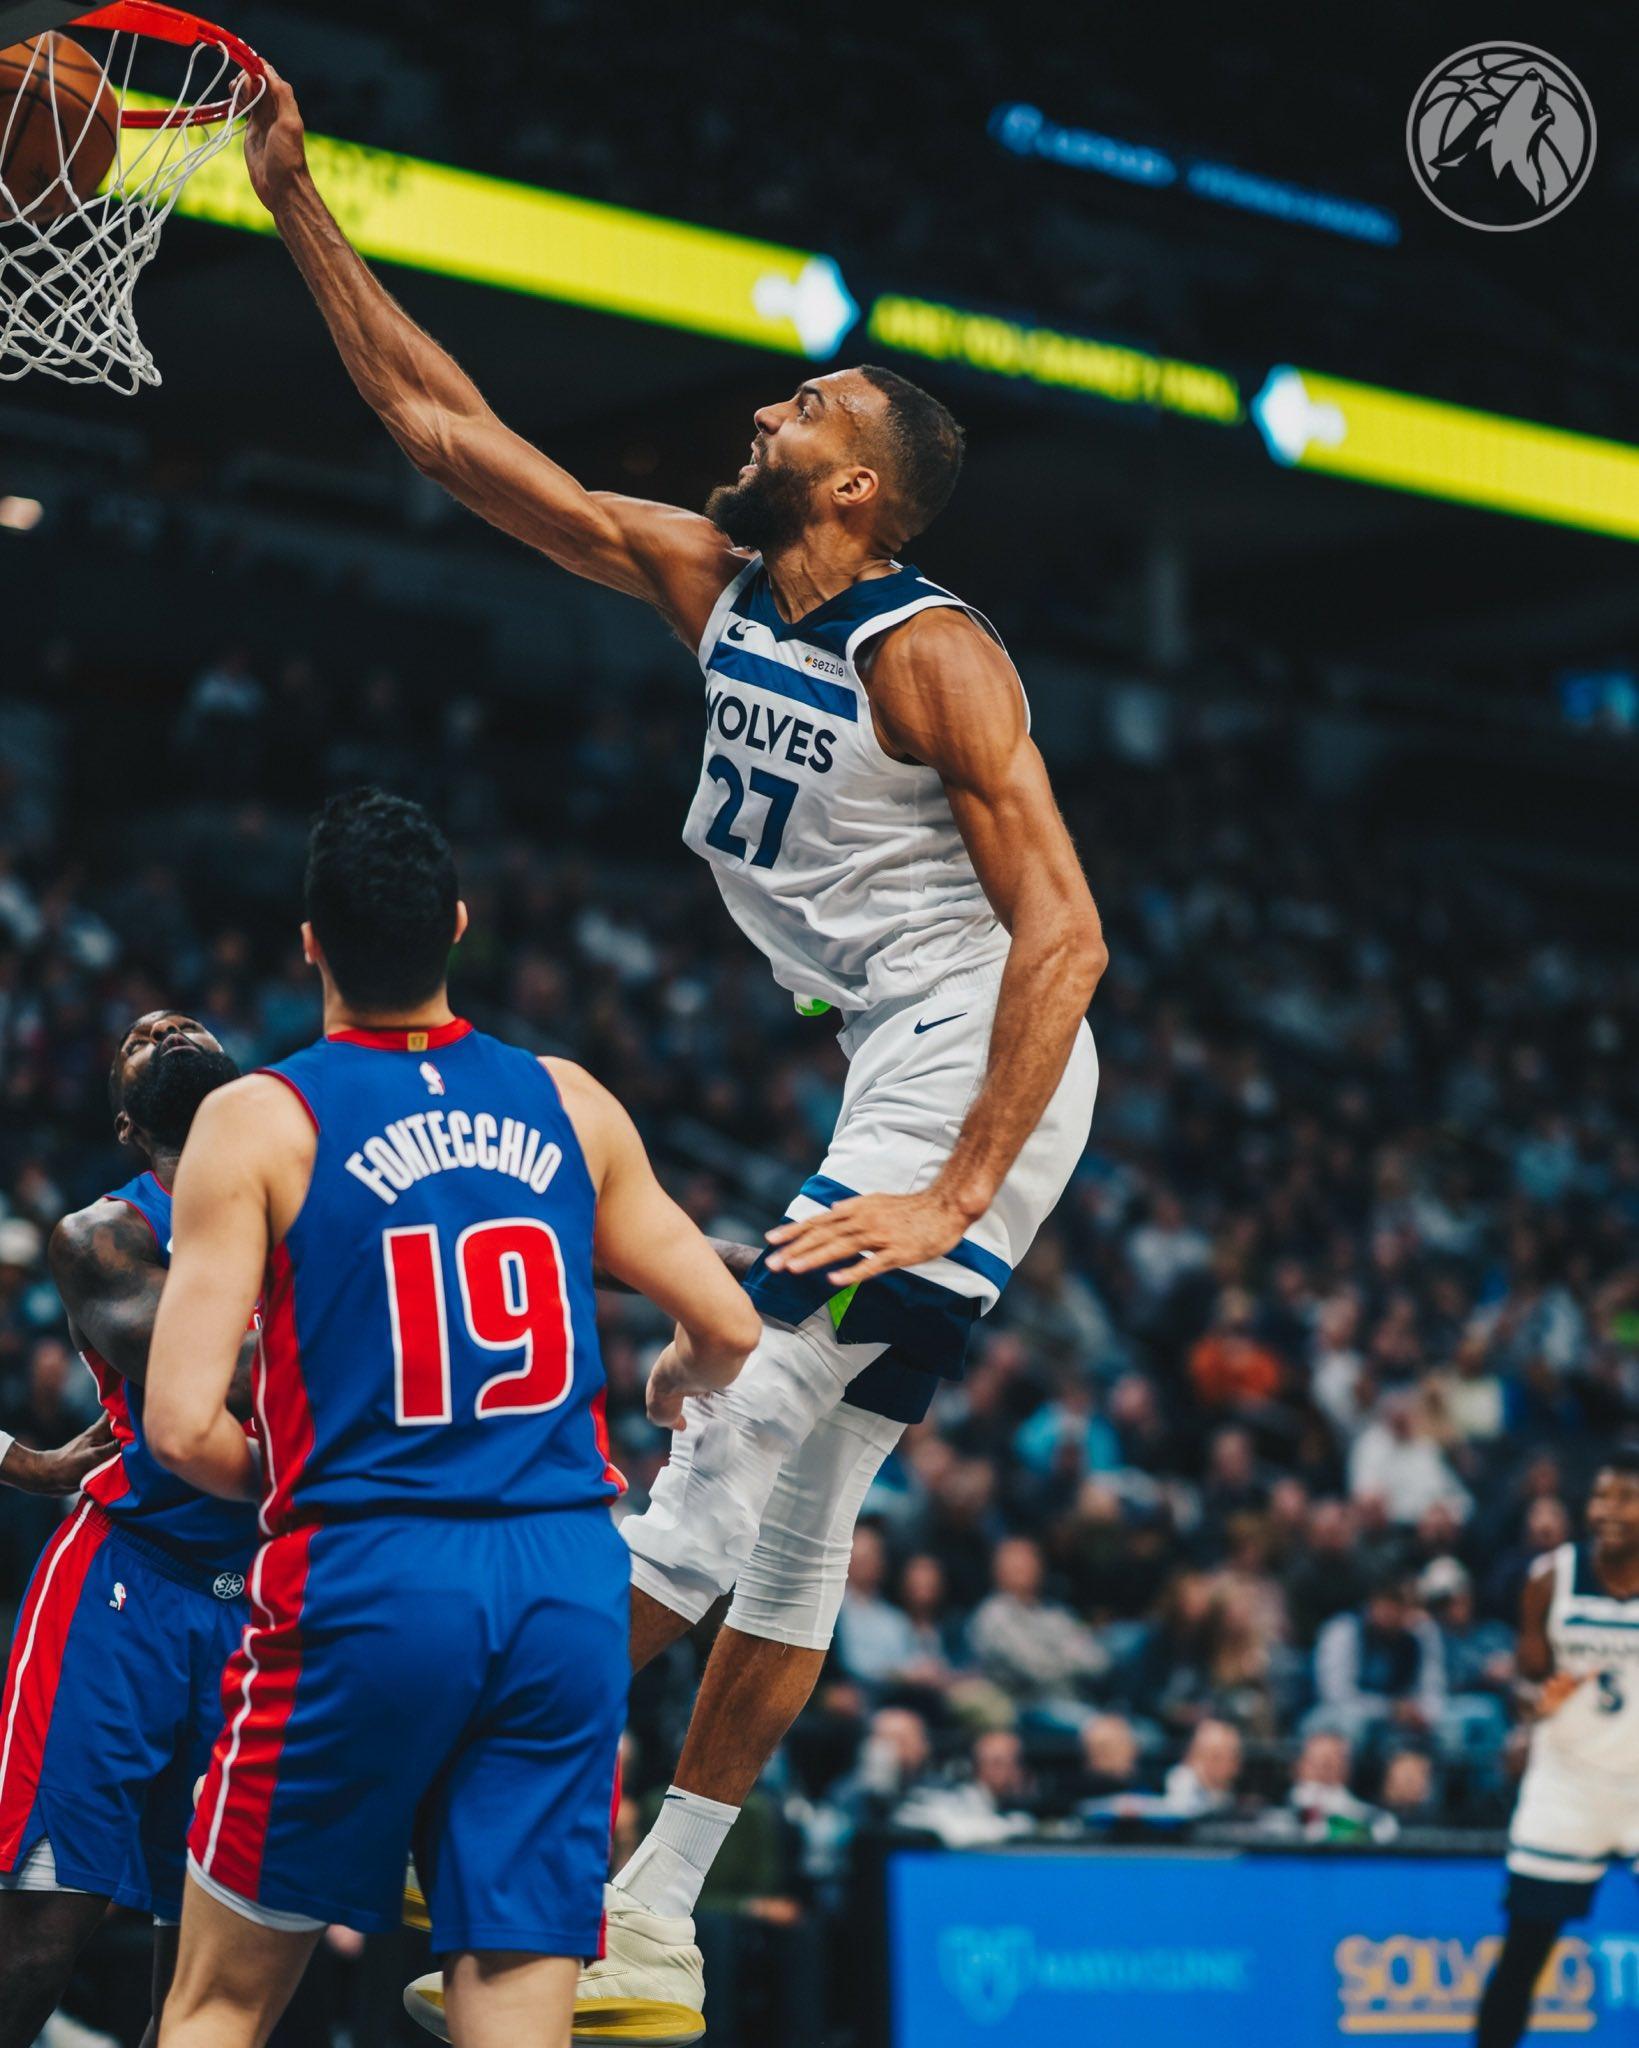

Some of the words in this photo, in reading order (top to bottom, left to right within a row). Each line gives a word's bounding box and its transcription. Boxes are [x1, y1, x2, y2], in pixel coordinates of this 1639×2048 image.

[811, 658, 844, 677] sezzle
[706, 754, 799, 870] 27
[344, 1109, 563, 1206] FONTECCHIO
[382, 1217, 575, 1427] 19
[1596, 1668, 1624, 1716] 5
